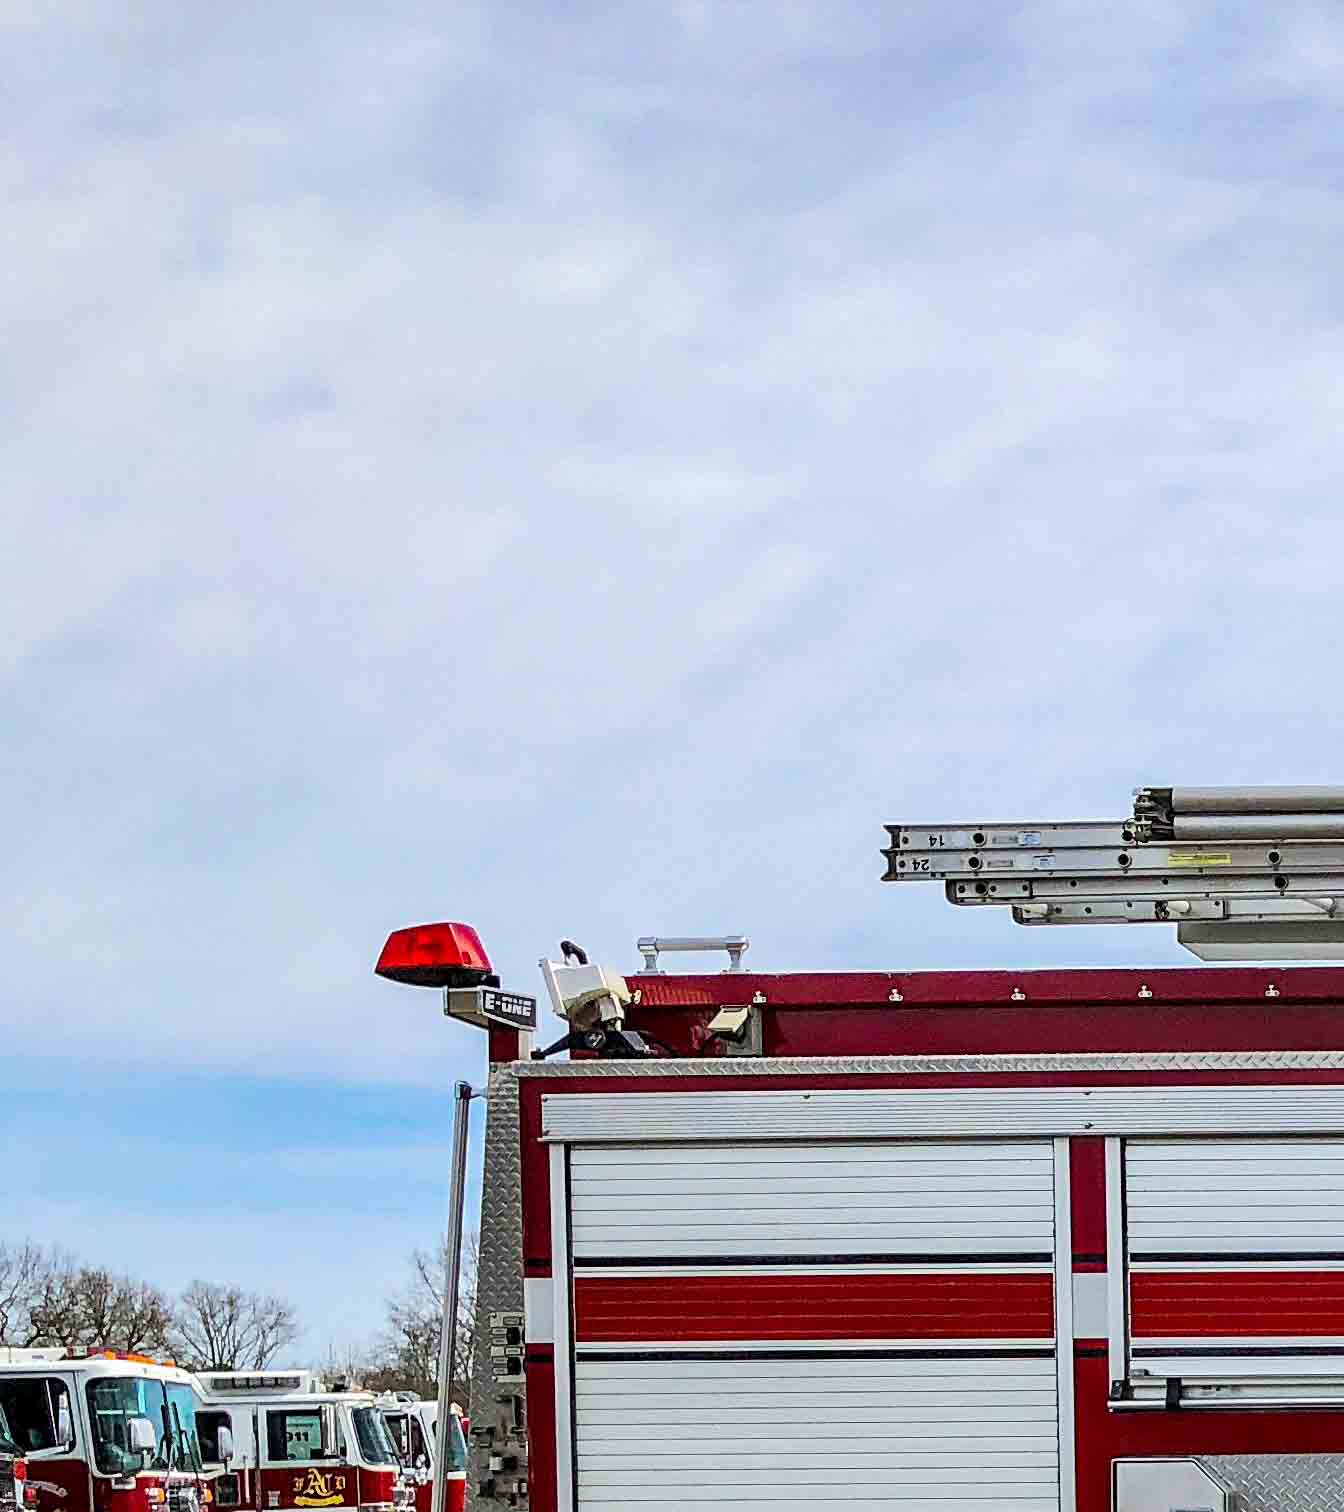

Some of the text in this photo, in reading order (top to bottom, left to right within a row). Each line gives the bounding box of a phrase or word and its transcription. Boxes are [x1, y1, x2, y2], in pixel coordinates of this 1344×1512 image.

[929, 834, 945, 847] 14
[912, 859, 930, 871] 24
[485, 993, 532, 1017] E-ONE
